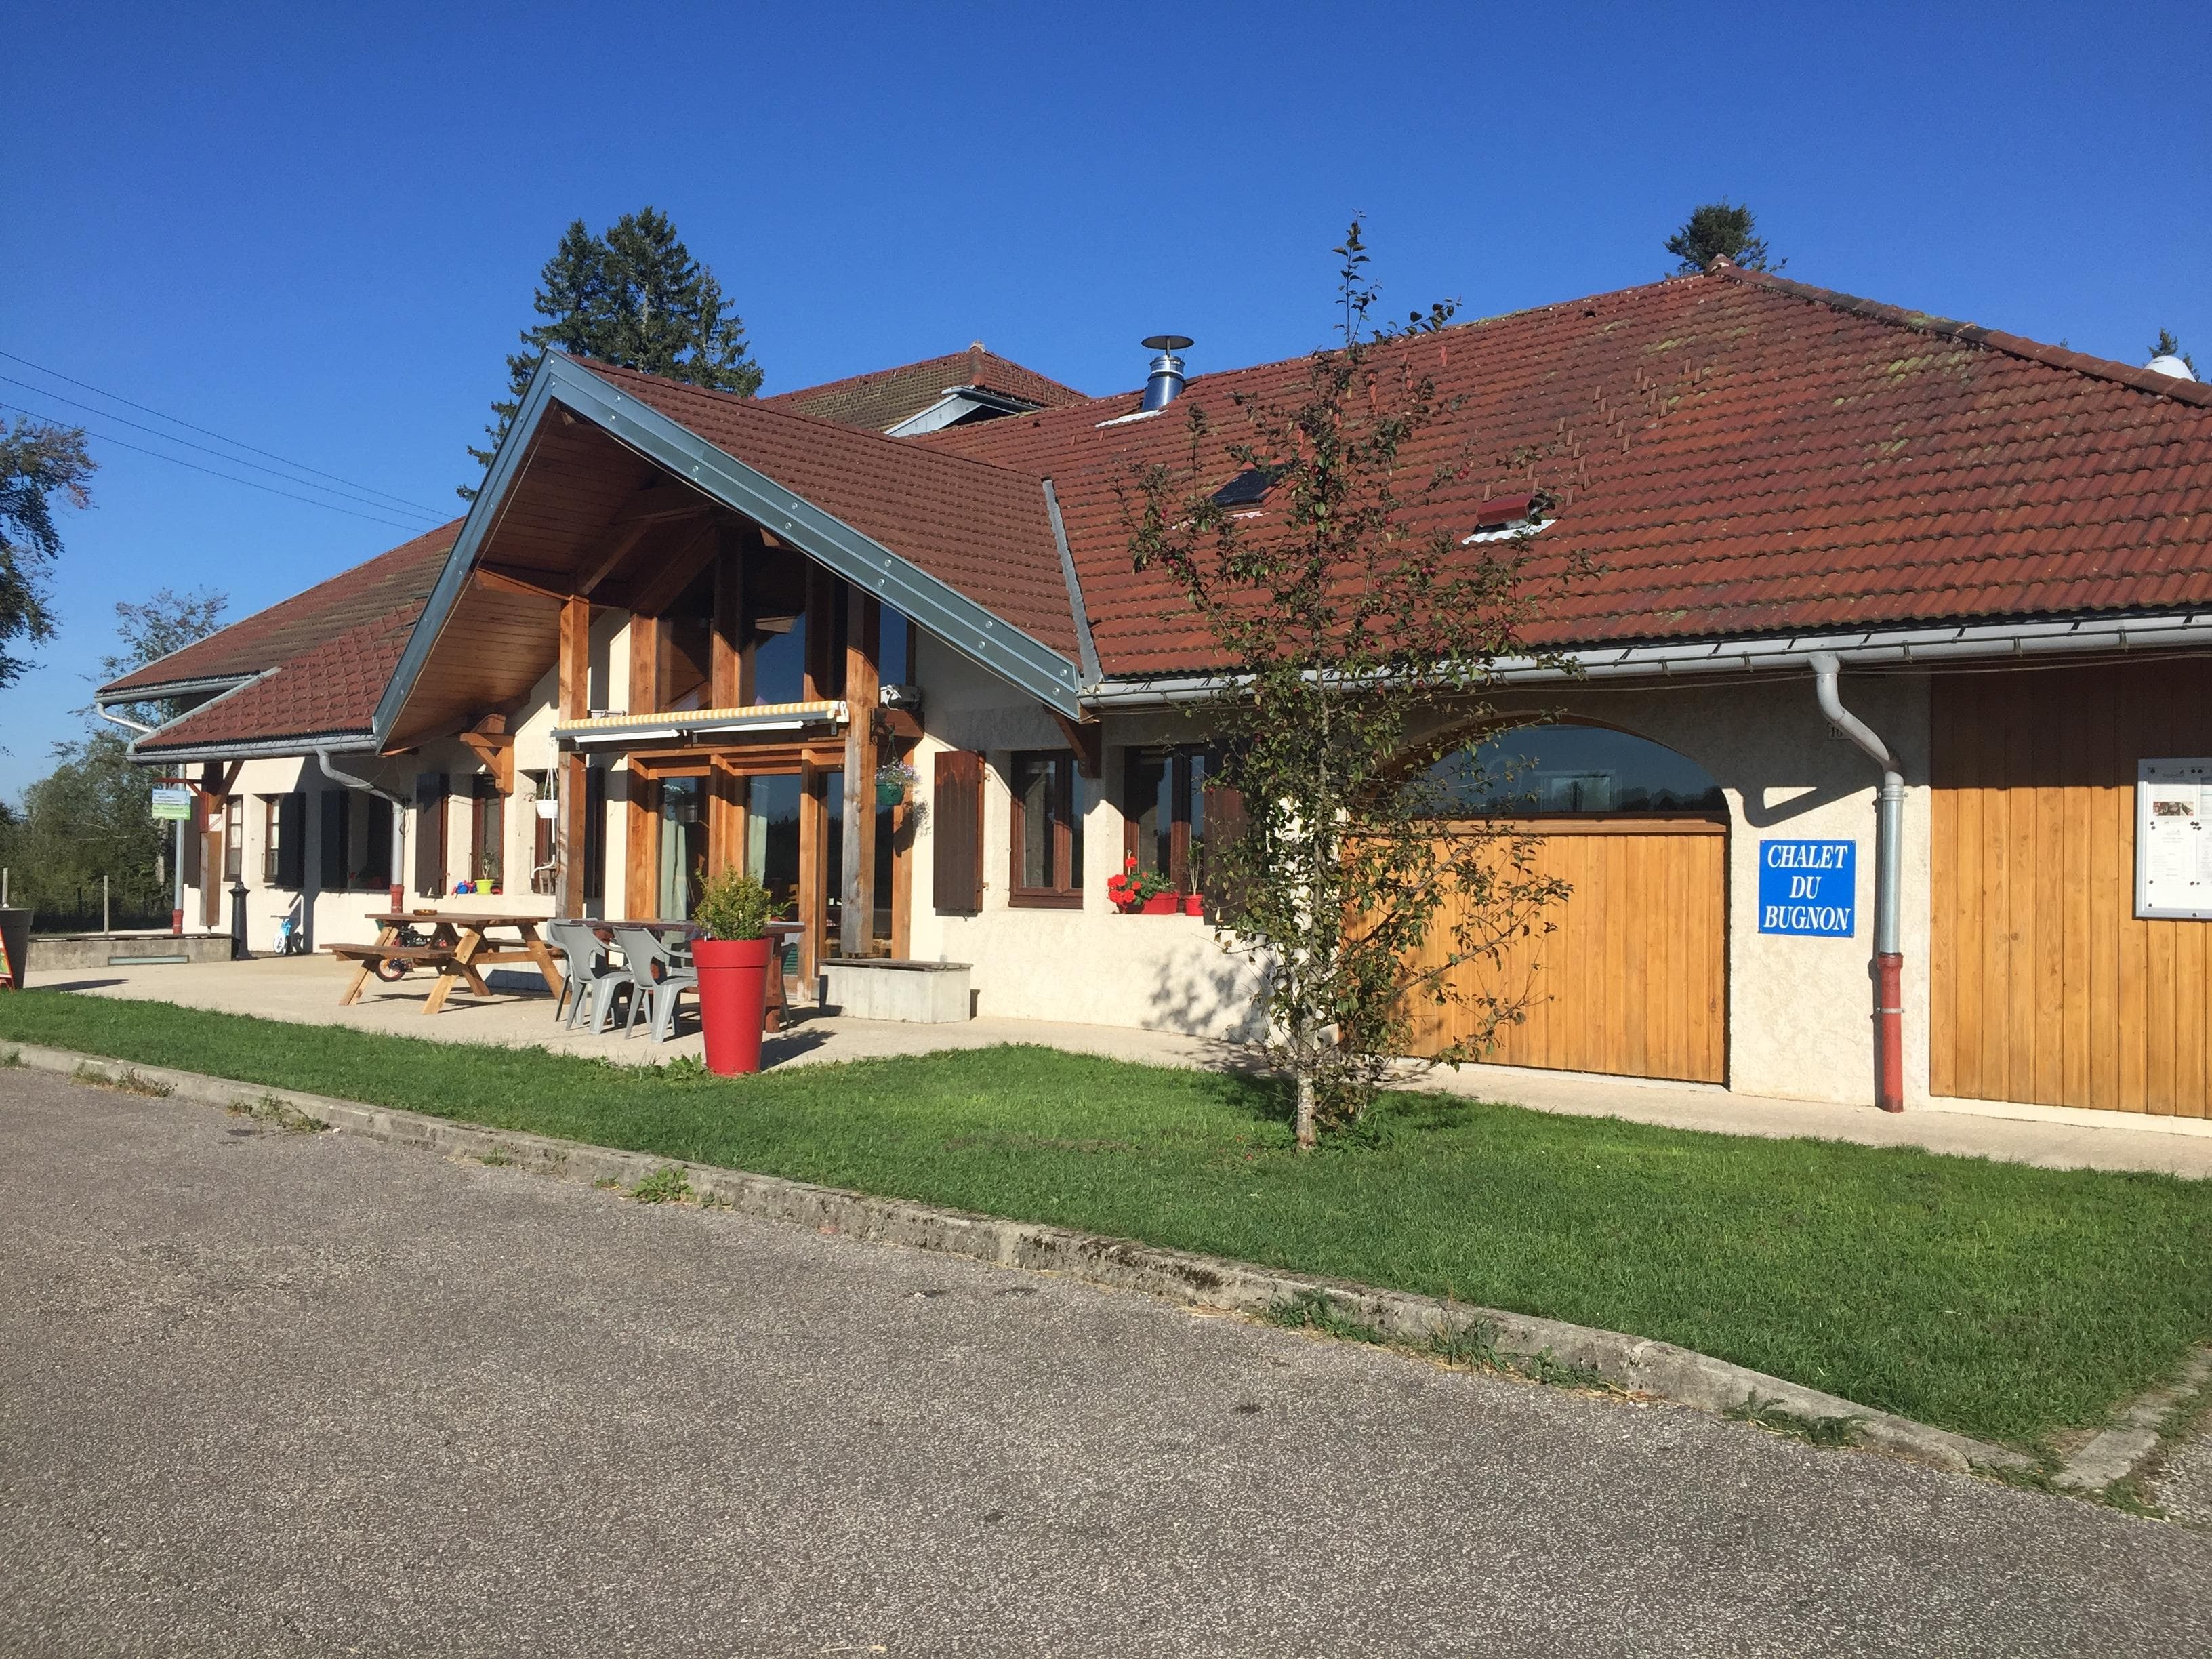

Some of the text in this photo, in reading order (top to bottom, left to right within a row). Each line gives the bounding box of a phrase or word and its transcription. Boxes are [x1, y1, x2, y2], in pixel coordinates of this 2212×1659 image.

[1767, 844, 1849, 869] CHALET
[1789, 876, 1822, 899] DU
[1763, 905, 1851, 931] BUGNON
